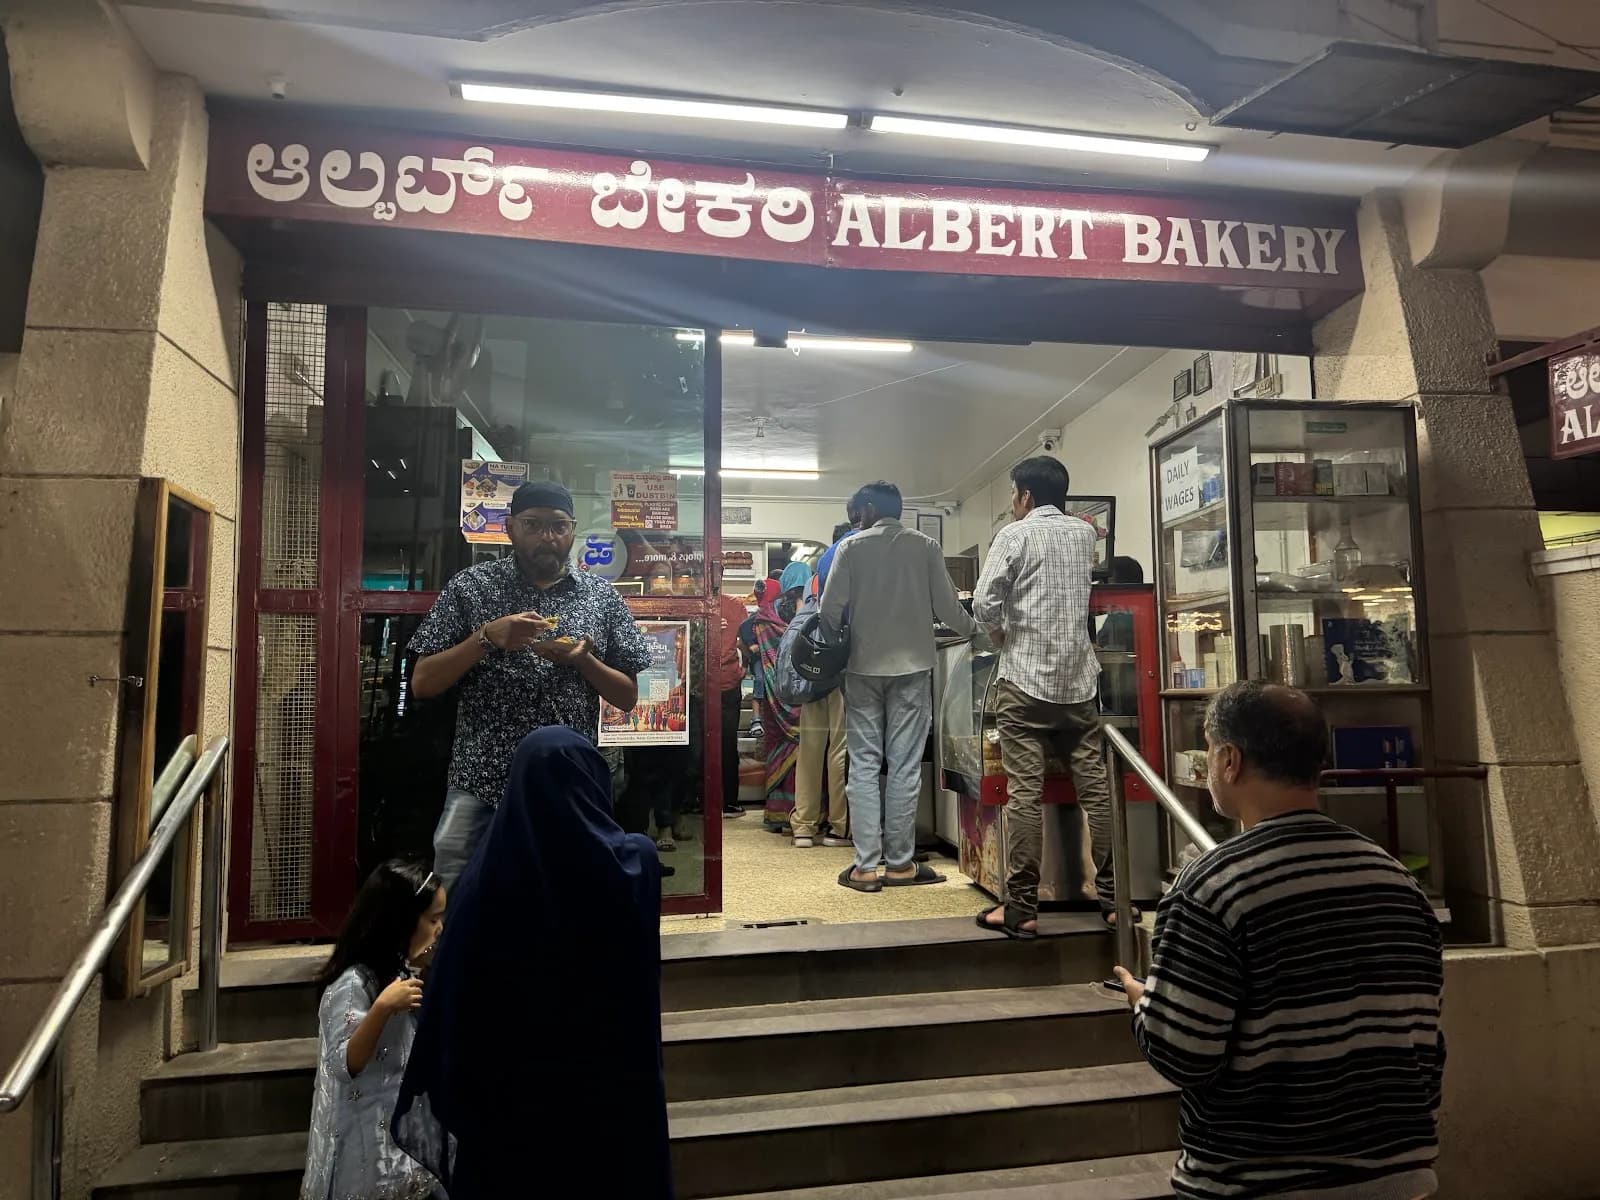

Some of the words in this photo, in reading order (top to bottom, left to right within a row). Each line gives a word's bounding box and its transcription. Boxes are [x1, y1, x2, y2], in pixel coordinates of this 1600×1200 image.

[590, 160, 815, 243] ಬೇಕರಿ
[832, 192, 1095, 261] ALBERT
[1121, 214, 1347, 276] BAKERY
[1166, 459, 1190, 484] DAILY
[1164, 486, 1195, 512] WAGES
